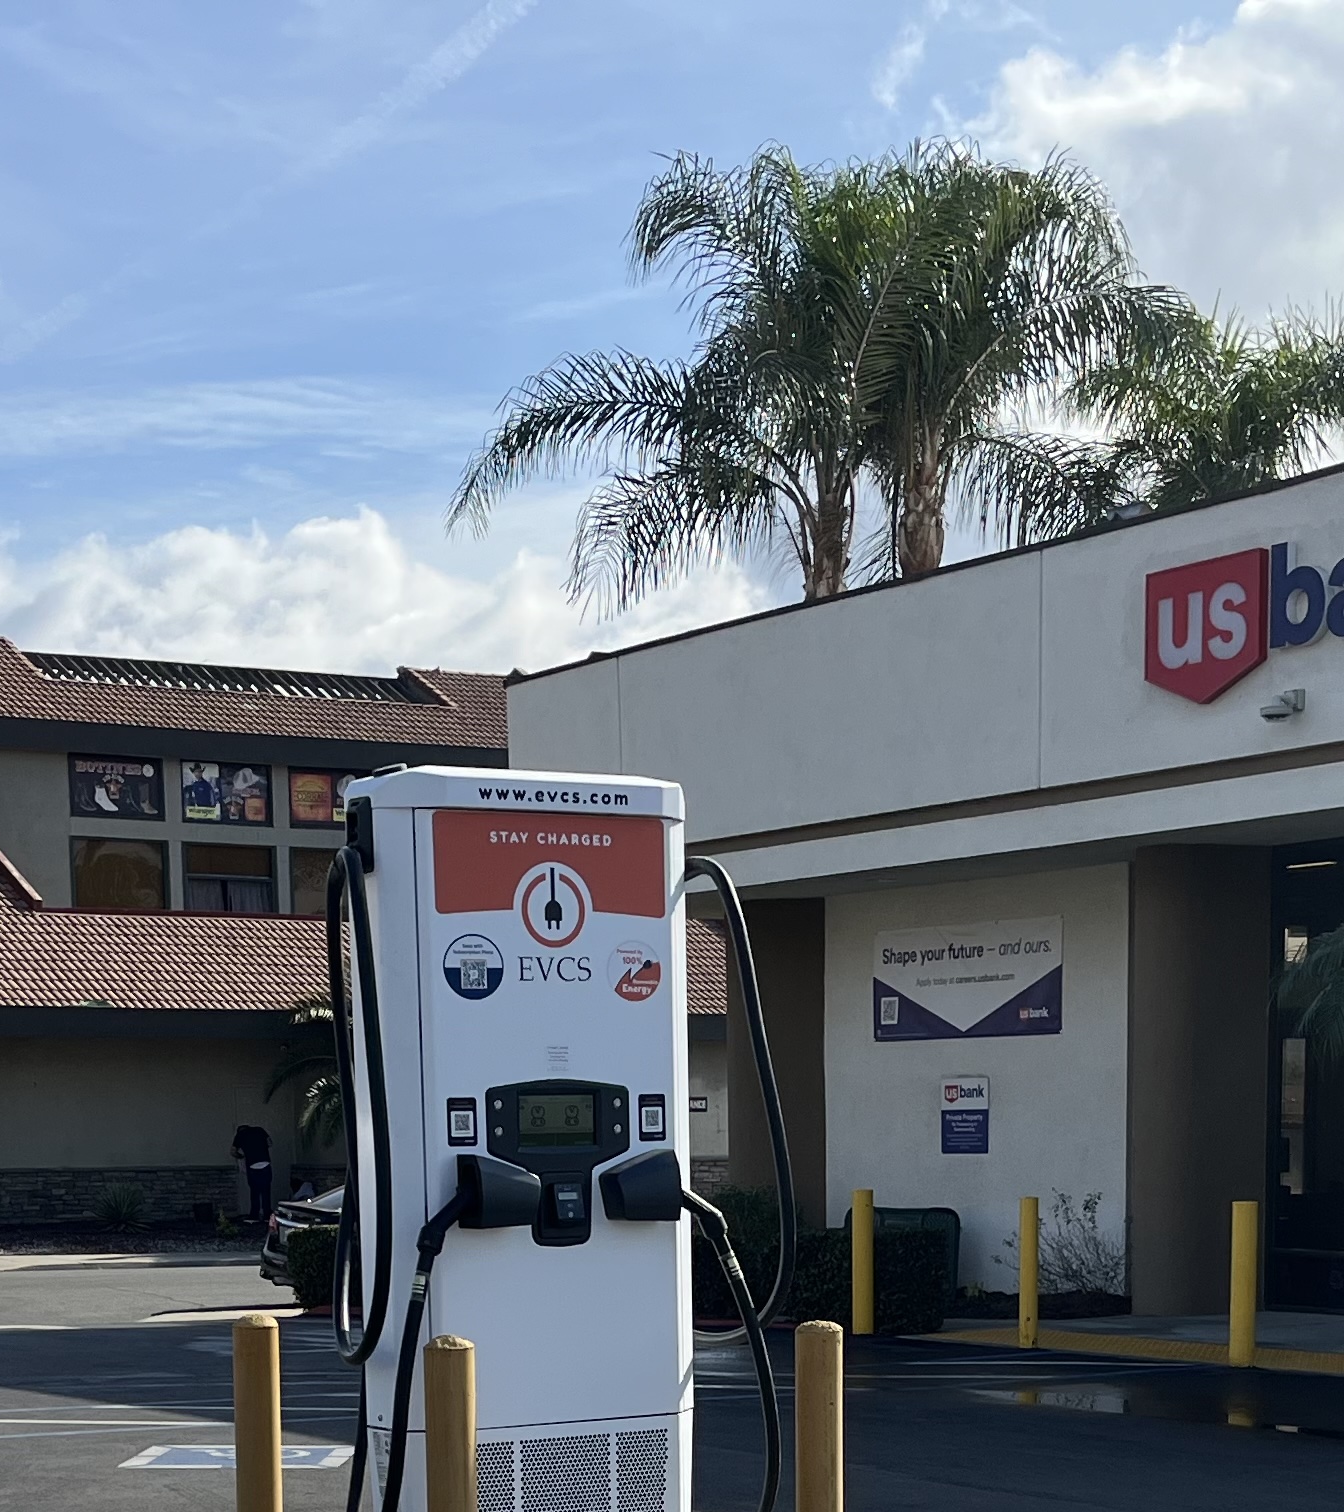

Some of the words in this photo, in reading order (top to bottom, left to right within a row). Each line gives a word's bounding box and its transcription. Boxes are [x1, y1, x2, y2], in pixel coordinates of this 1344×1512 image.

[478, 787, 629, 806] www.evcs.com
[489, 831, 528, 844] STAY
[537, 832, 612, 846] CHARGED
[622, 956, 643, 965] 100%
[882, 947, 917, 967] Shape
[920, 948, 945, 966] your
[948, 943, 984, 959] future
[998, 937, 1022, 956] and
[1024, 940, 1051, 954] ours.
[517, 955, 592, 982] EVCS
[622, 983, 652, 995] Energy
